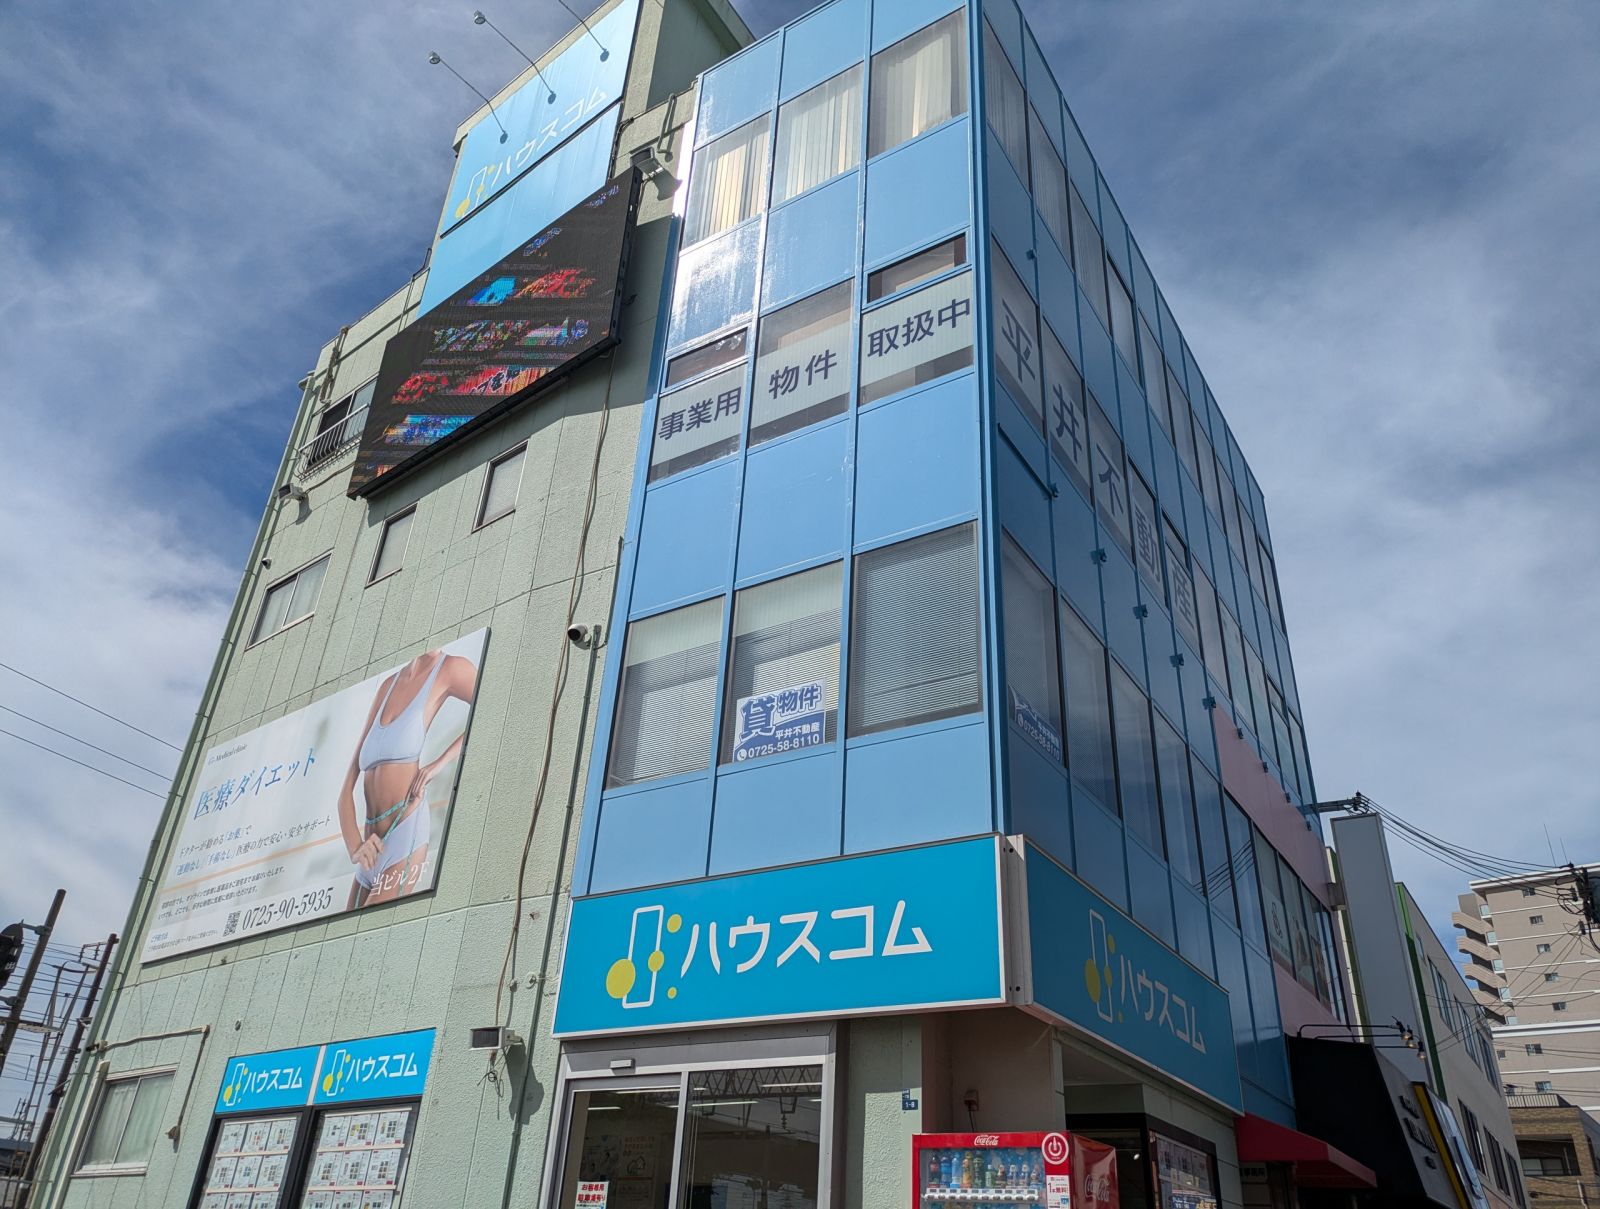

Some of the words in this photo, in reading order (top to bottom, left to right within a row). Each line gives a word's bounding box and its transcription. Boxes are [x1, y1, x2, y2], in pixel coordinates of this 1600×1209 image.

[491, 86, 609, 188] ハウスコム
[658, 386, 742, 441] 事業用
[768, 349, 838, 400] 物件
[867, 298, 971, 358] 取扱中
[740, 683, 822, 742] 貸物件
[775, 721, 820, 740] 平井不動産
[748, 733, 820, 758] 0725-58-8110
[194, 747, 315, 821] 医療ダイエット
[242, 887, 335, 932] 0725-90-5935
[680, 900, 933, 979] ハウスコム
[1120, 954, 1206, 1054] ハウスコム
[243, 1066, 303, 1095] ハウスコム
[345, 1052, 418, 1083] ハウスコム
